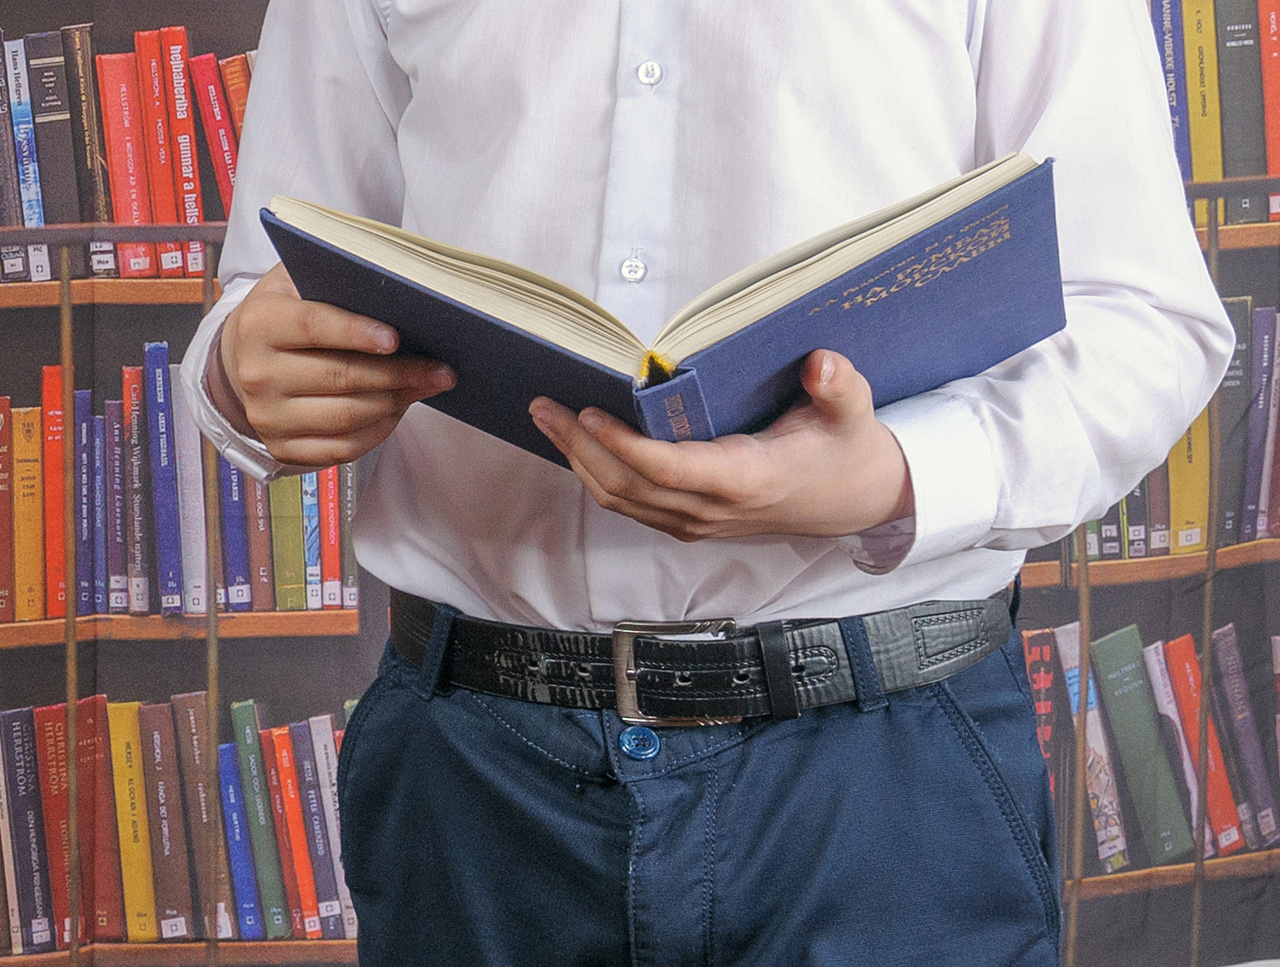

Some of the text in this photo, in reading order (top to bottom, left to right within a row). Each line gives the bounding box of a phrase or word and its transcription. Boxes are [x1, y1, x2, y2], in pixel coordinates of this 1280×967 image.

[170, 45, 194, 190] hejbaberiba gunnar a
[1166, 74, 1177, 107] HOLST
[841, 214, 1008, 311] НА РУМБАХ
[865, 223, 1009, 306] МОРСКОЙ
[913, 231, 1010, 287] СЛАВЫ
[130, 384, 143, 571] Carl-Henning Wijkmark Stundande natten
[43, 721, 58, 795] HERRSTRÖM
[55, 723, 68, 790] CHRISTINA
